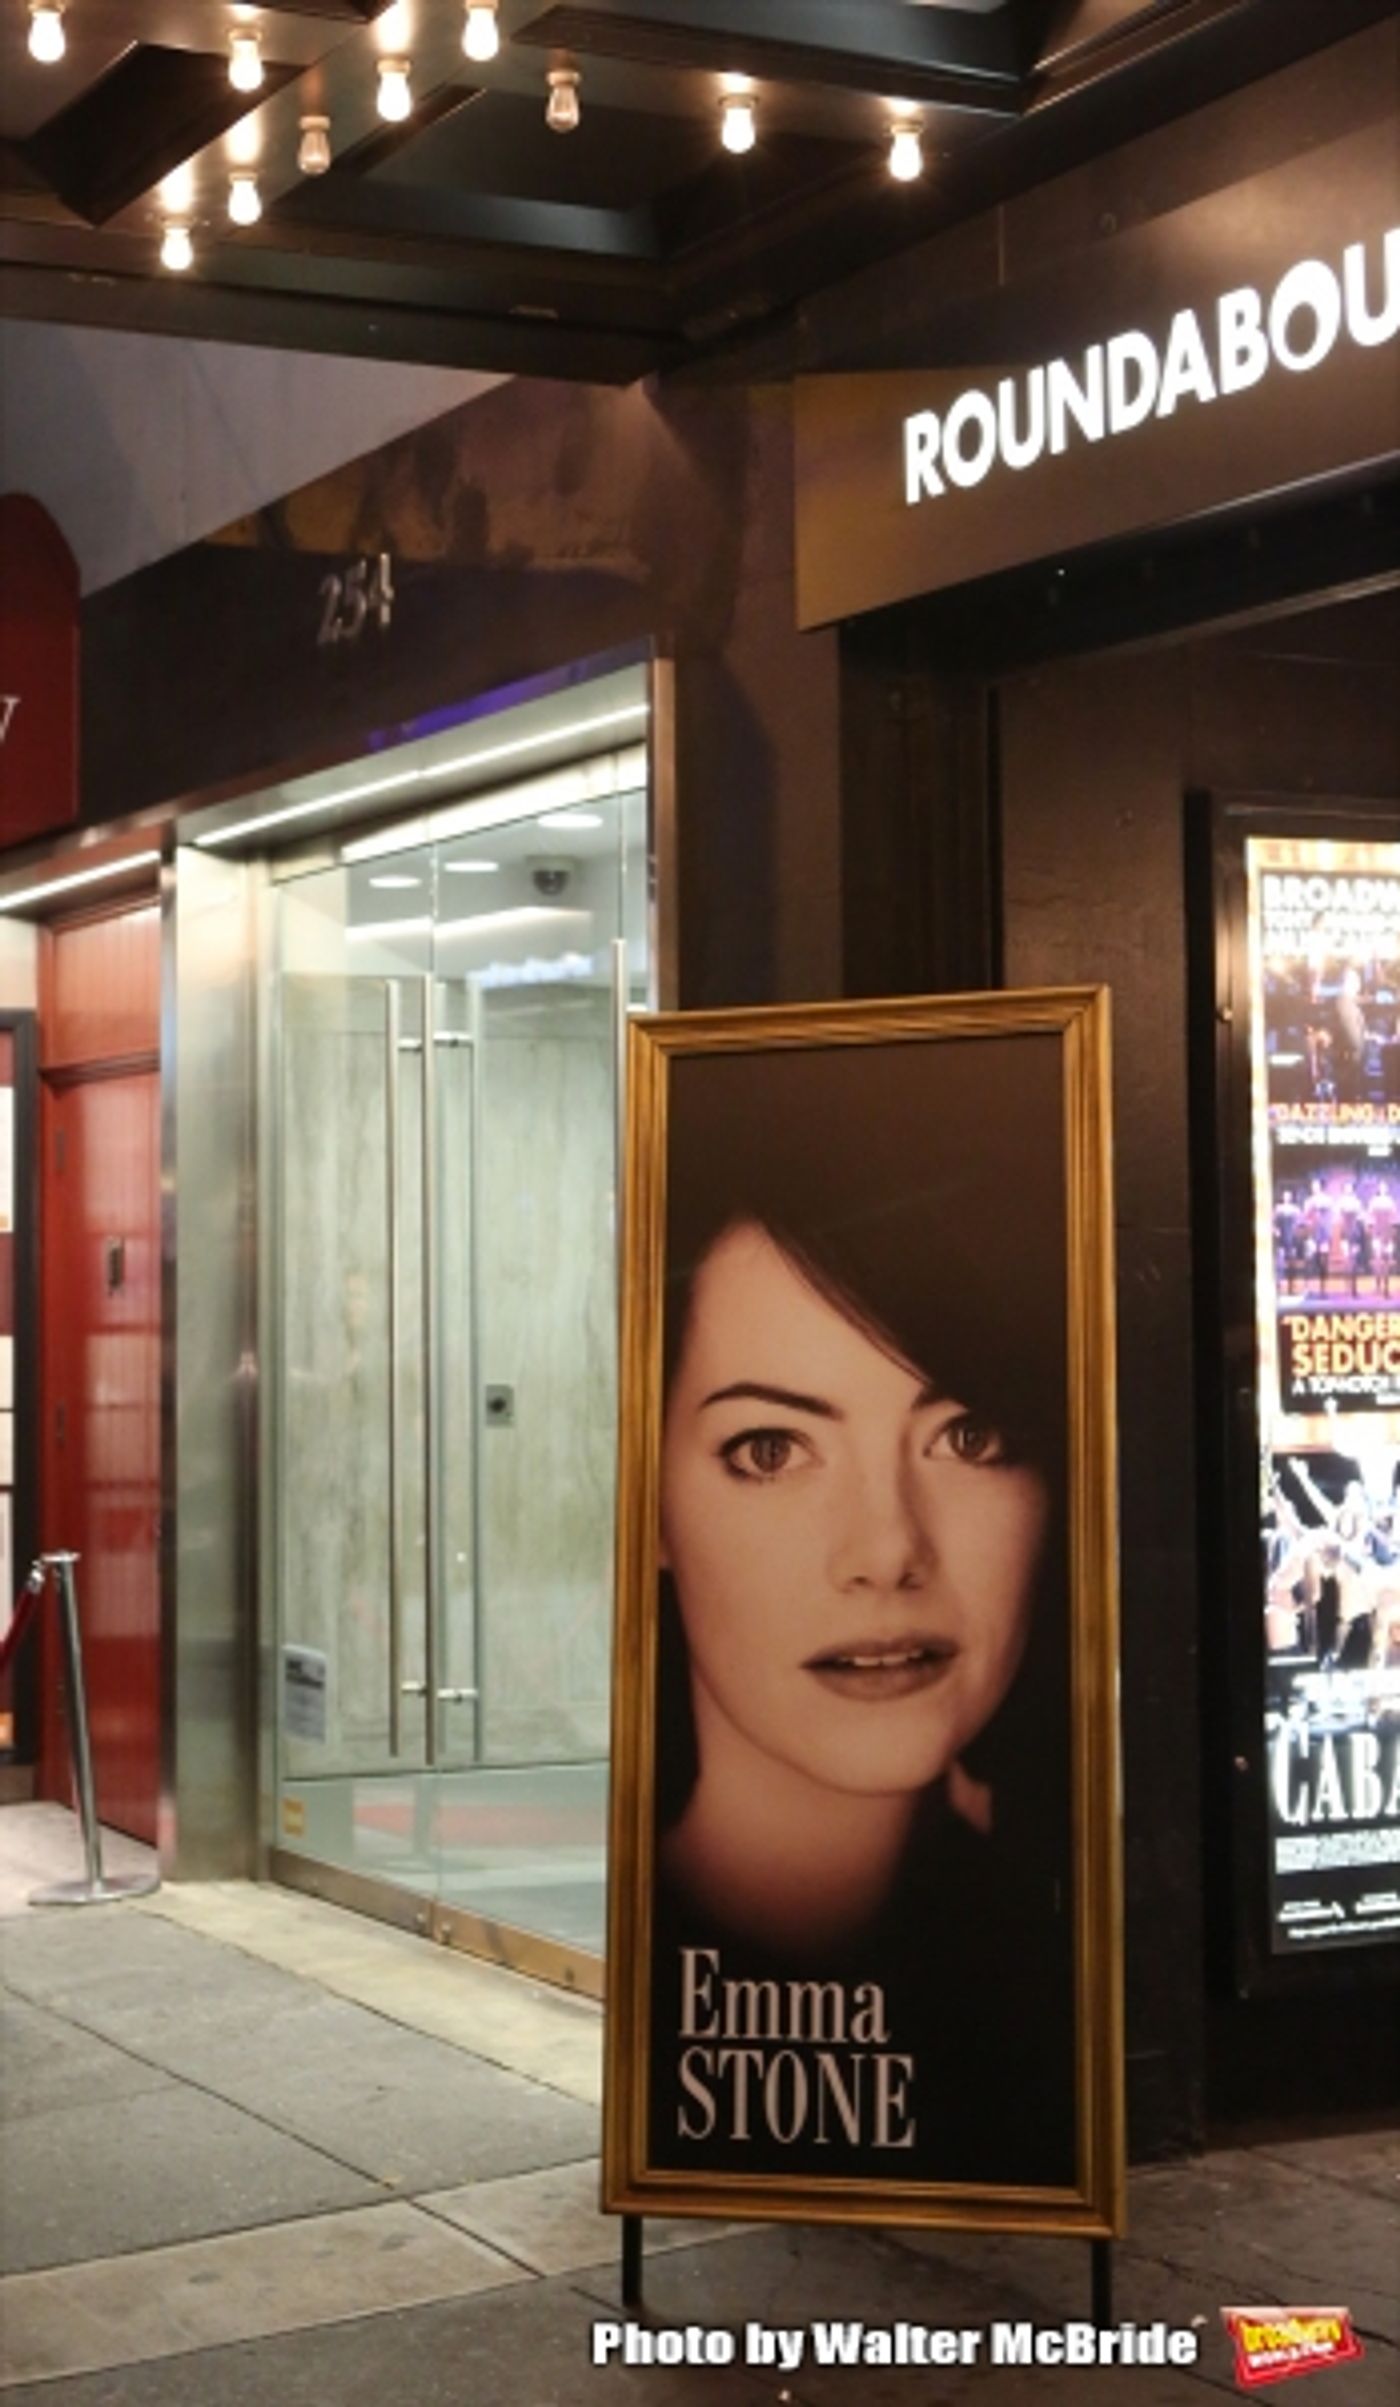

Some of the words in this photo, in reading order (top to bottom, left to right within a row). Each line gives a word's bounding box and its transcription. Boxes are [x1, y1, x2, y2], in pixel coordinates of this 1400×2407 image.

[317, 553, 395, 645] 254
[679, 1946, 891, 2044] Emma
[678, 2045, 916, 2148] STONE
